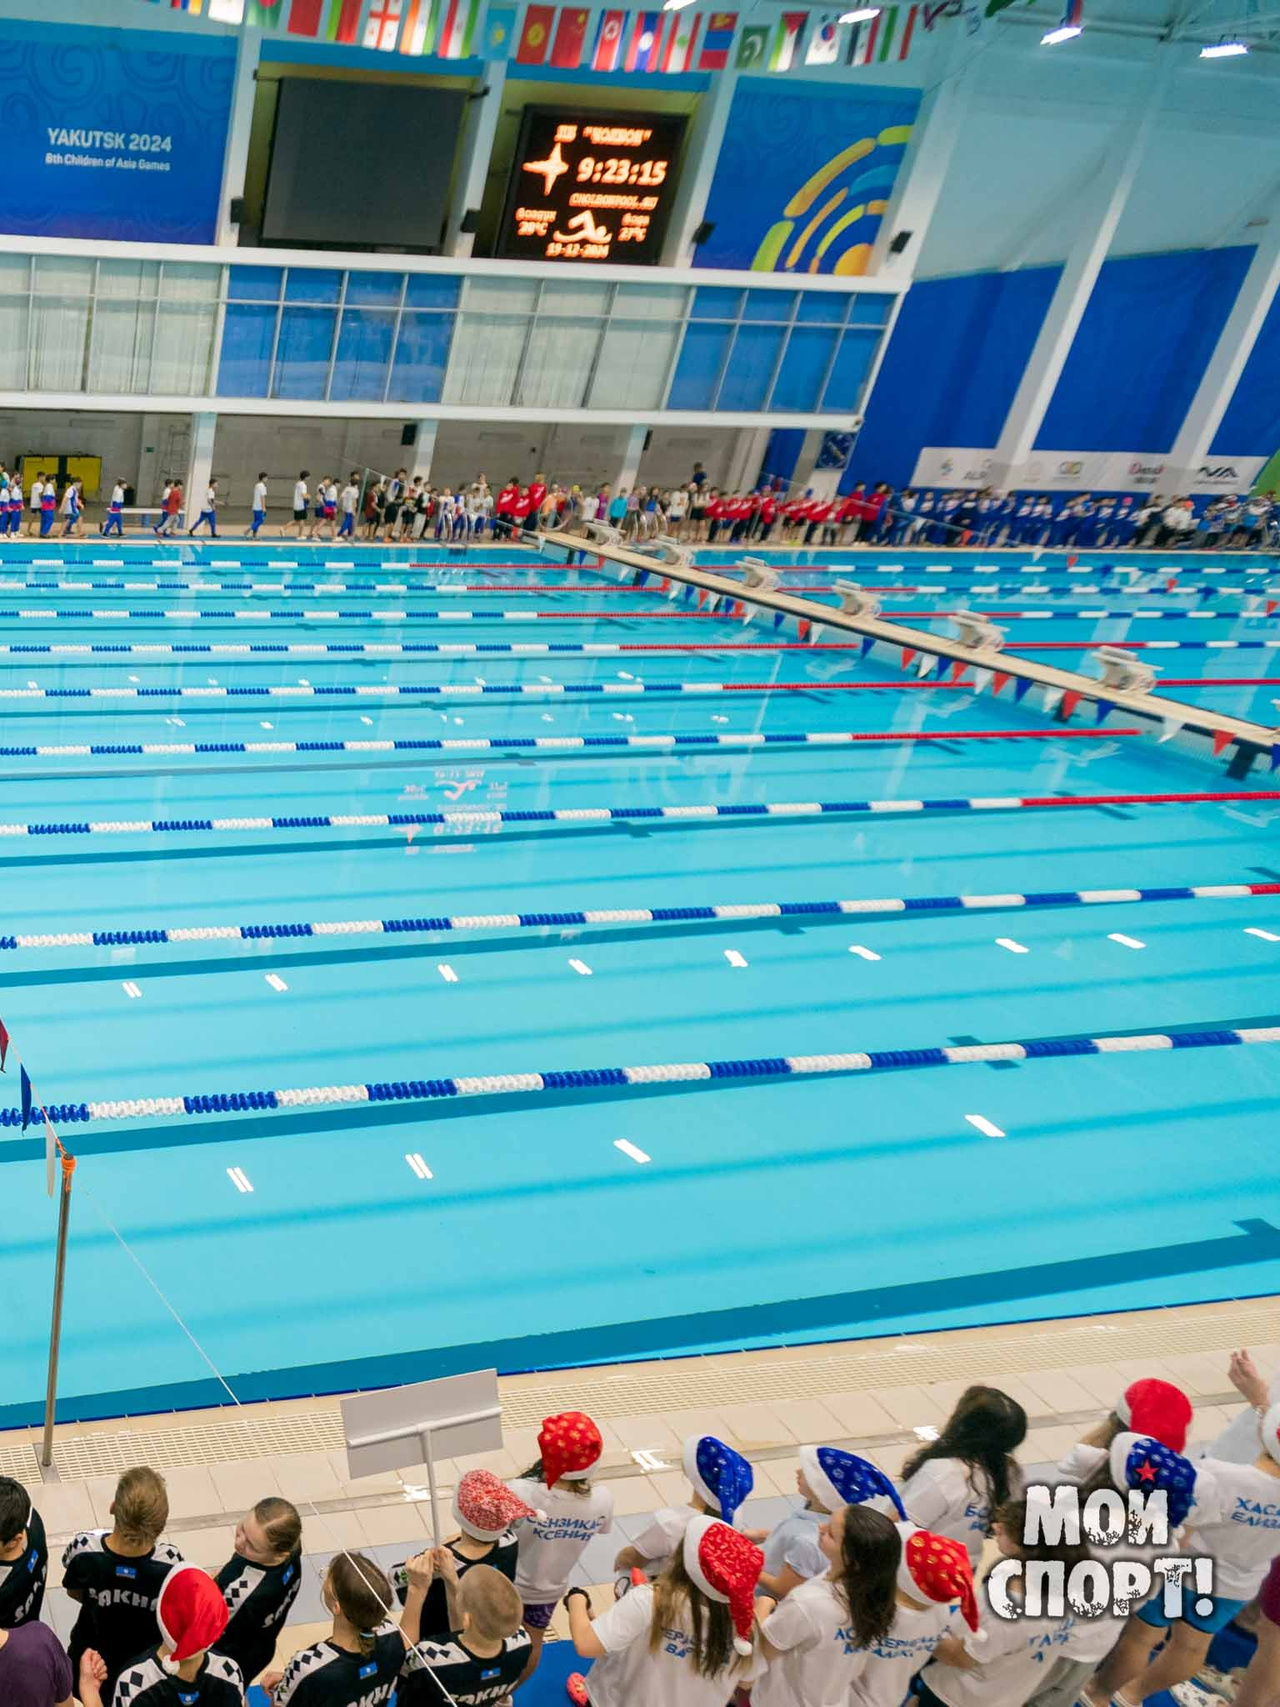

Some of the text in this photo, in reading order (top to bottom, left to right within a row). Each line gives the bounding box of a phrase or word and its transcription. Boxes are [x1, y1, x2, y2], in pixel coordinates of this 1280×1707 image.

[47, 127, 172, 152] YAKUTSK 2024
[45, 152, 170, 171] 8th Children of Asia Games
[576, 157, 668, 186] 9:23:15
